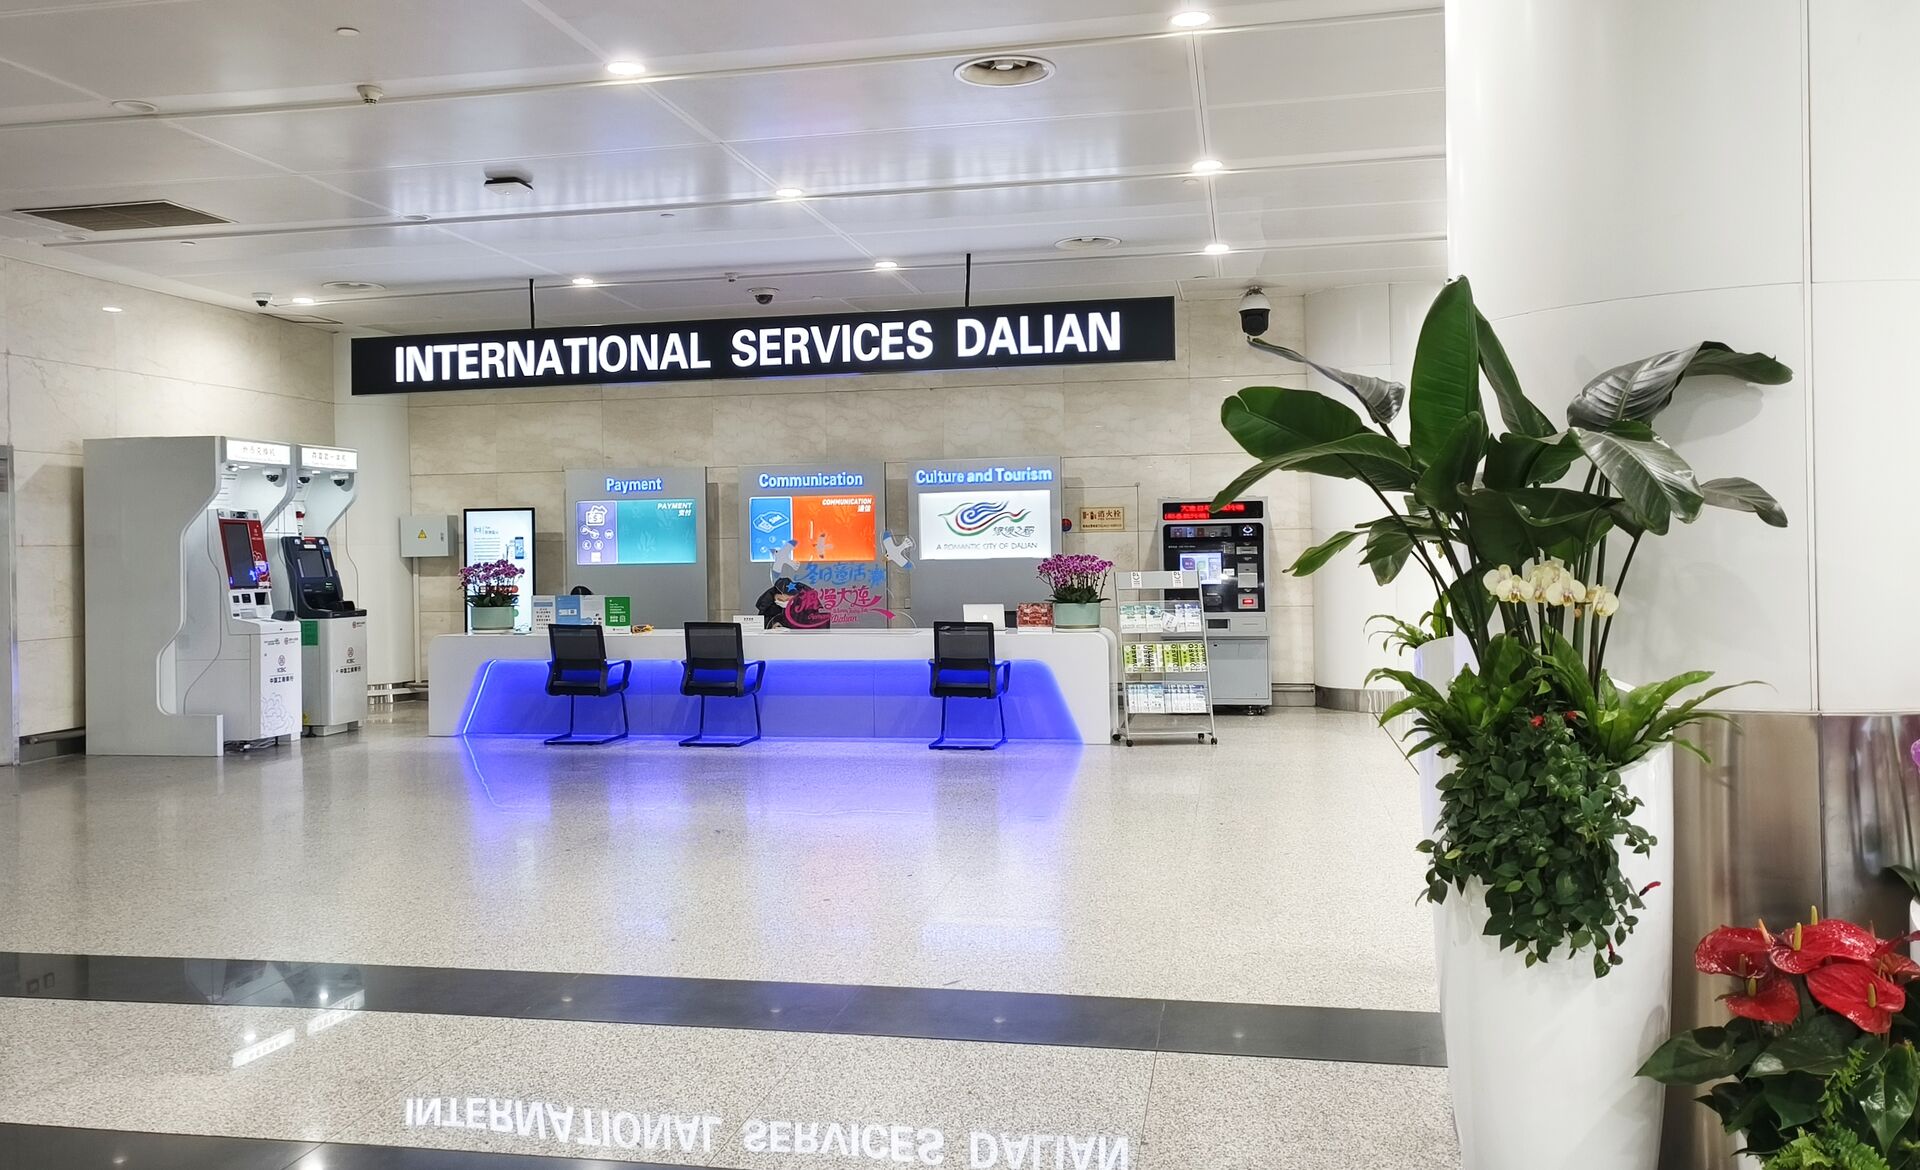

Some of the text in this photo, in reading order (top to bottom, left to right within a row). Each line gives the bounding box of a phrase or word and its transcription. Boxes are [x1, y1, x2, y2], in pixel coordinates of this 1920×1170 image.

[395, 310, 1122, 384] INTERNATIONAL SERVICES DALIAN
[758, 471, 864, 489] Communication
[915, 466, 1053, 484] Culture and Tourism
[605, 477, 662, 494] Payment
[657, 502, 693, 510] PAYMENT
[822, 498, 872, 506] COMMUNICATION
[1097, 510, 1121, 518] 消火栓
[999, 542, 1008, 550] OF
[1011, 542, 1038, 550] DALIAN
